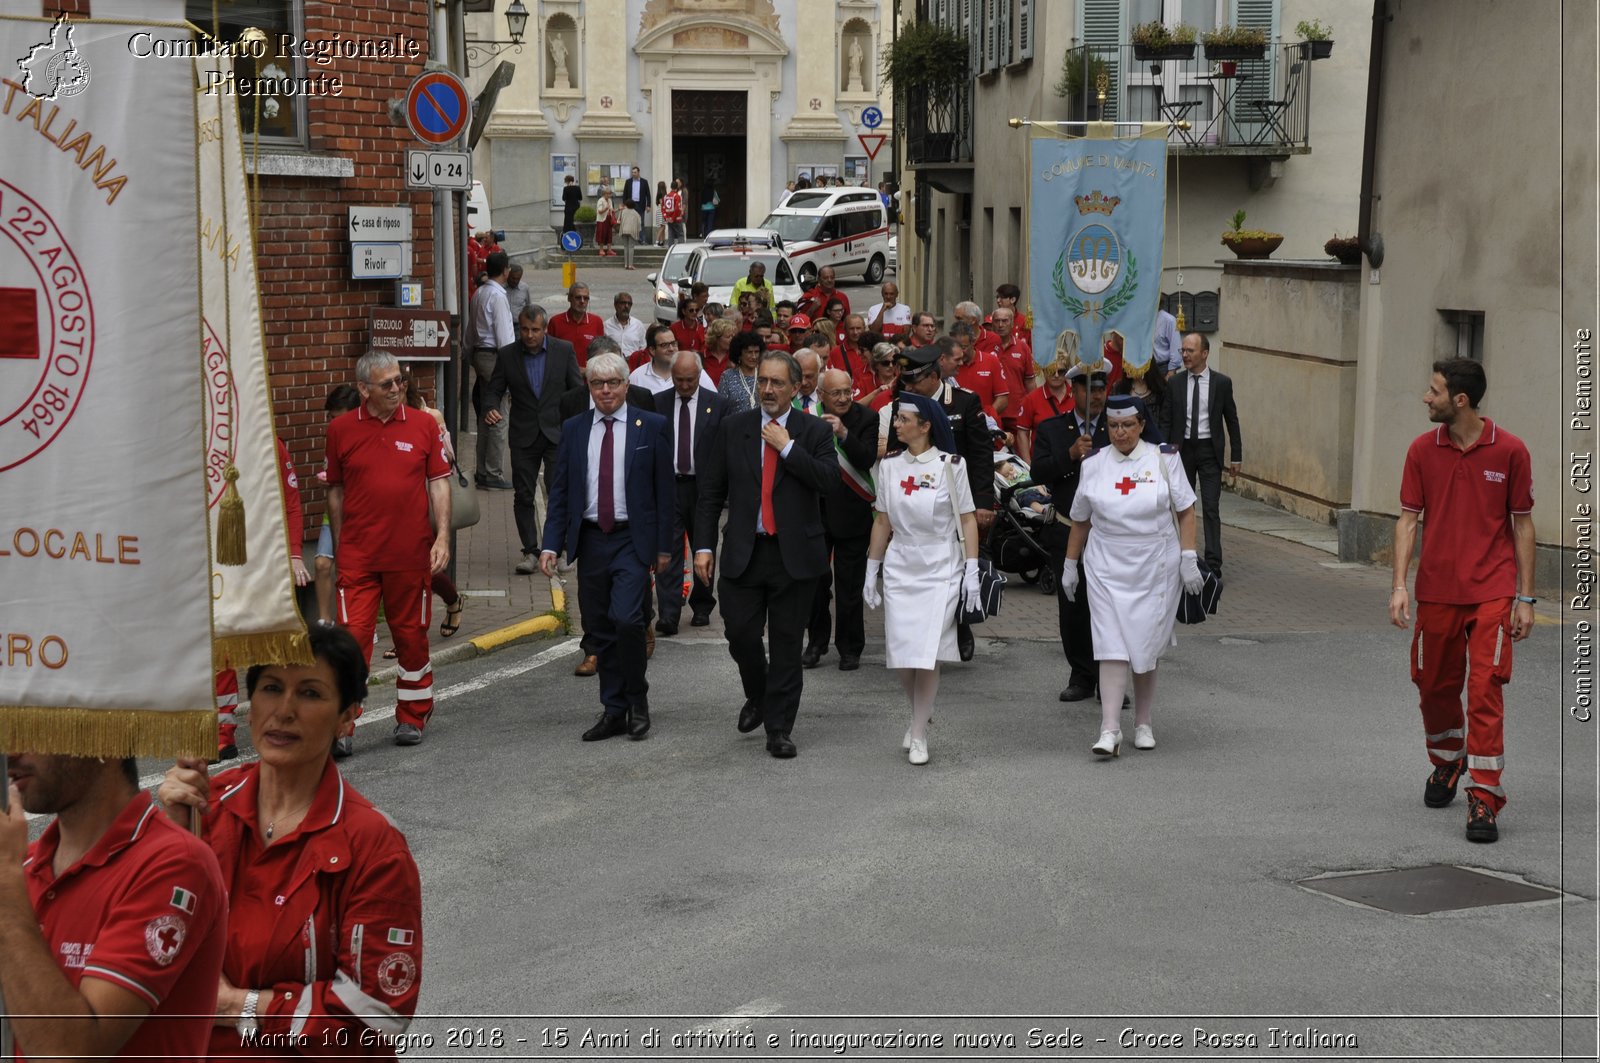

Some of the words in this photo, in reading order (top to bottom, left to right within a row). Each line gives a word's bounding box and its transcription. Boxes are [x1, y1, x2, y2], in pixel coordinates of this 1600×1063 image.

[1098, 155, 1109, 167] DI
[1114, 157, 1158, 184] MANTA
[8, 206, 47, 245] 22
[362, 219, 375, 228] casa
[376, 217, 381, 228] di
[383, 217, 401, 230] riposo
[39, 246, 86, 378] AGOSTO
[373, 319, 403, 330] VERZUOLO
[409, 318, 414, 331] 2
[372, 336, 397, 347] GUILLESTRE
[404, 335, 414, 347] 105
[21, 384, 71, 439] 1864
